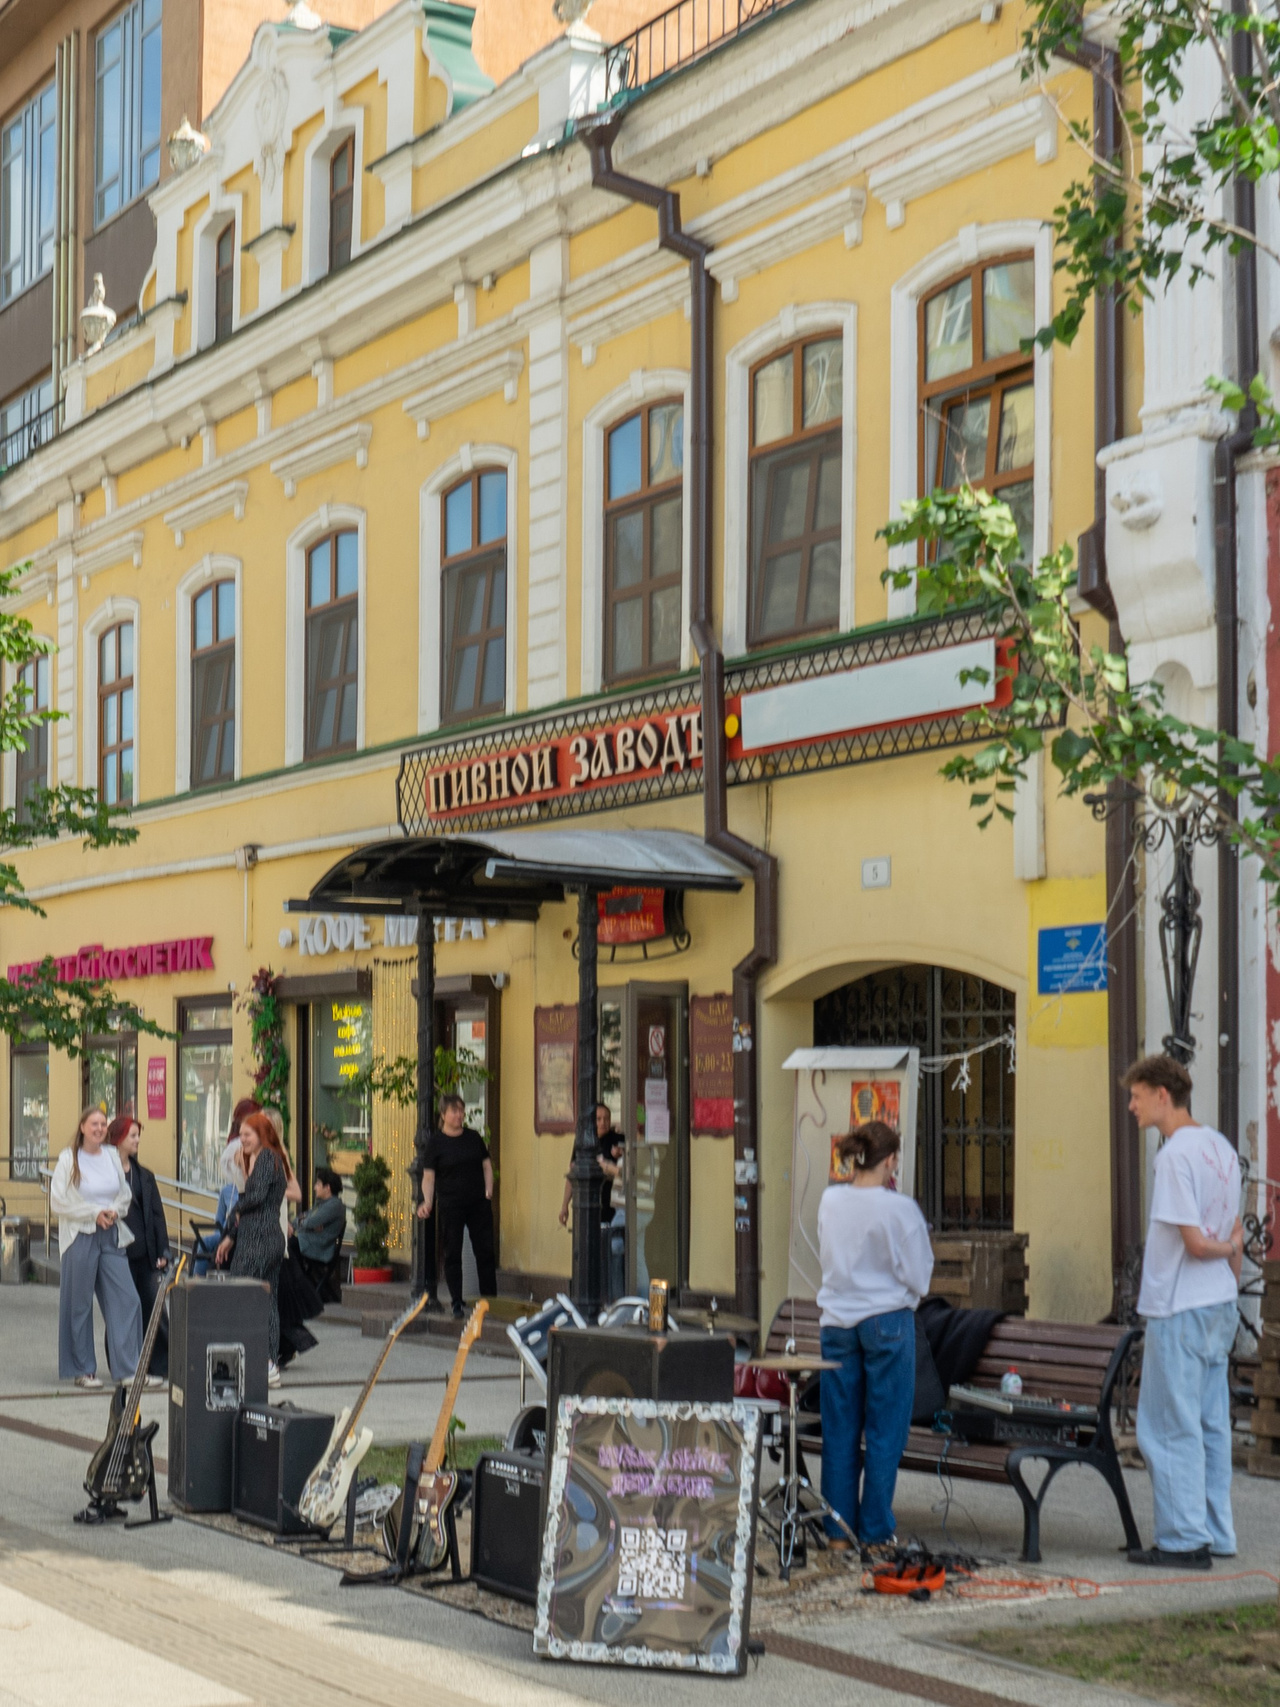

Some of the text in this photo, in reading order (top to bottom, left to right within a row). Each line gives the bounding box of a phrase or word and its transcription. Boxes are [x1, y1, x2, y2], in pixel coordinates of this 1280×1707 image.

[429, 746, 554, 813] ПИВНОЙ
[298, 912, 371, 956] КОФЕ
[99, 937, 207, 980] КОСМЕТИК
